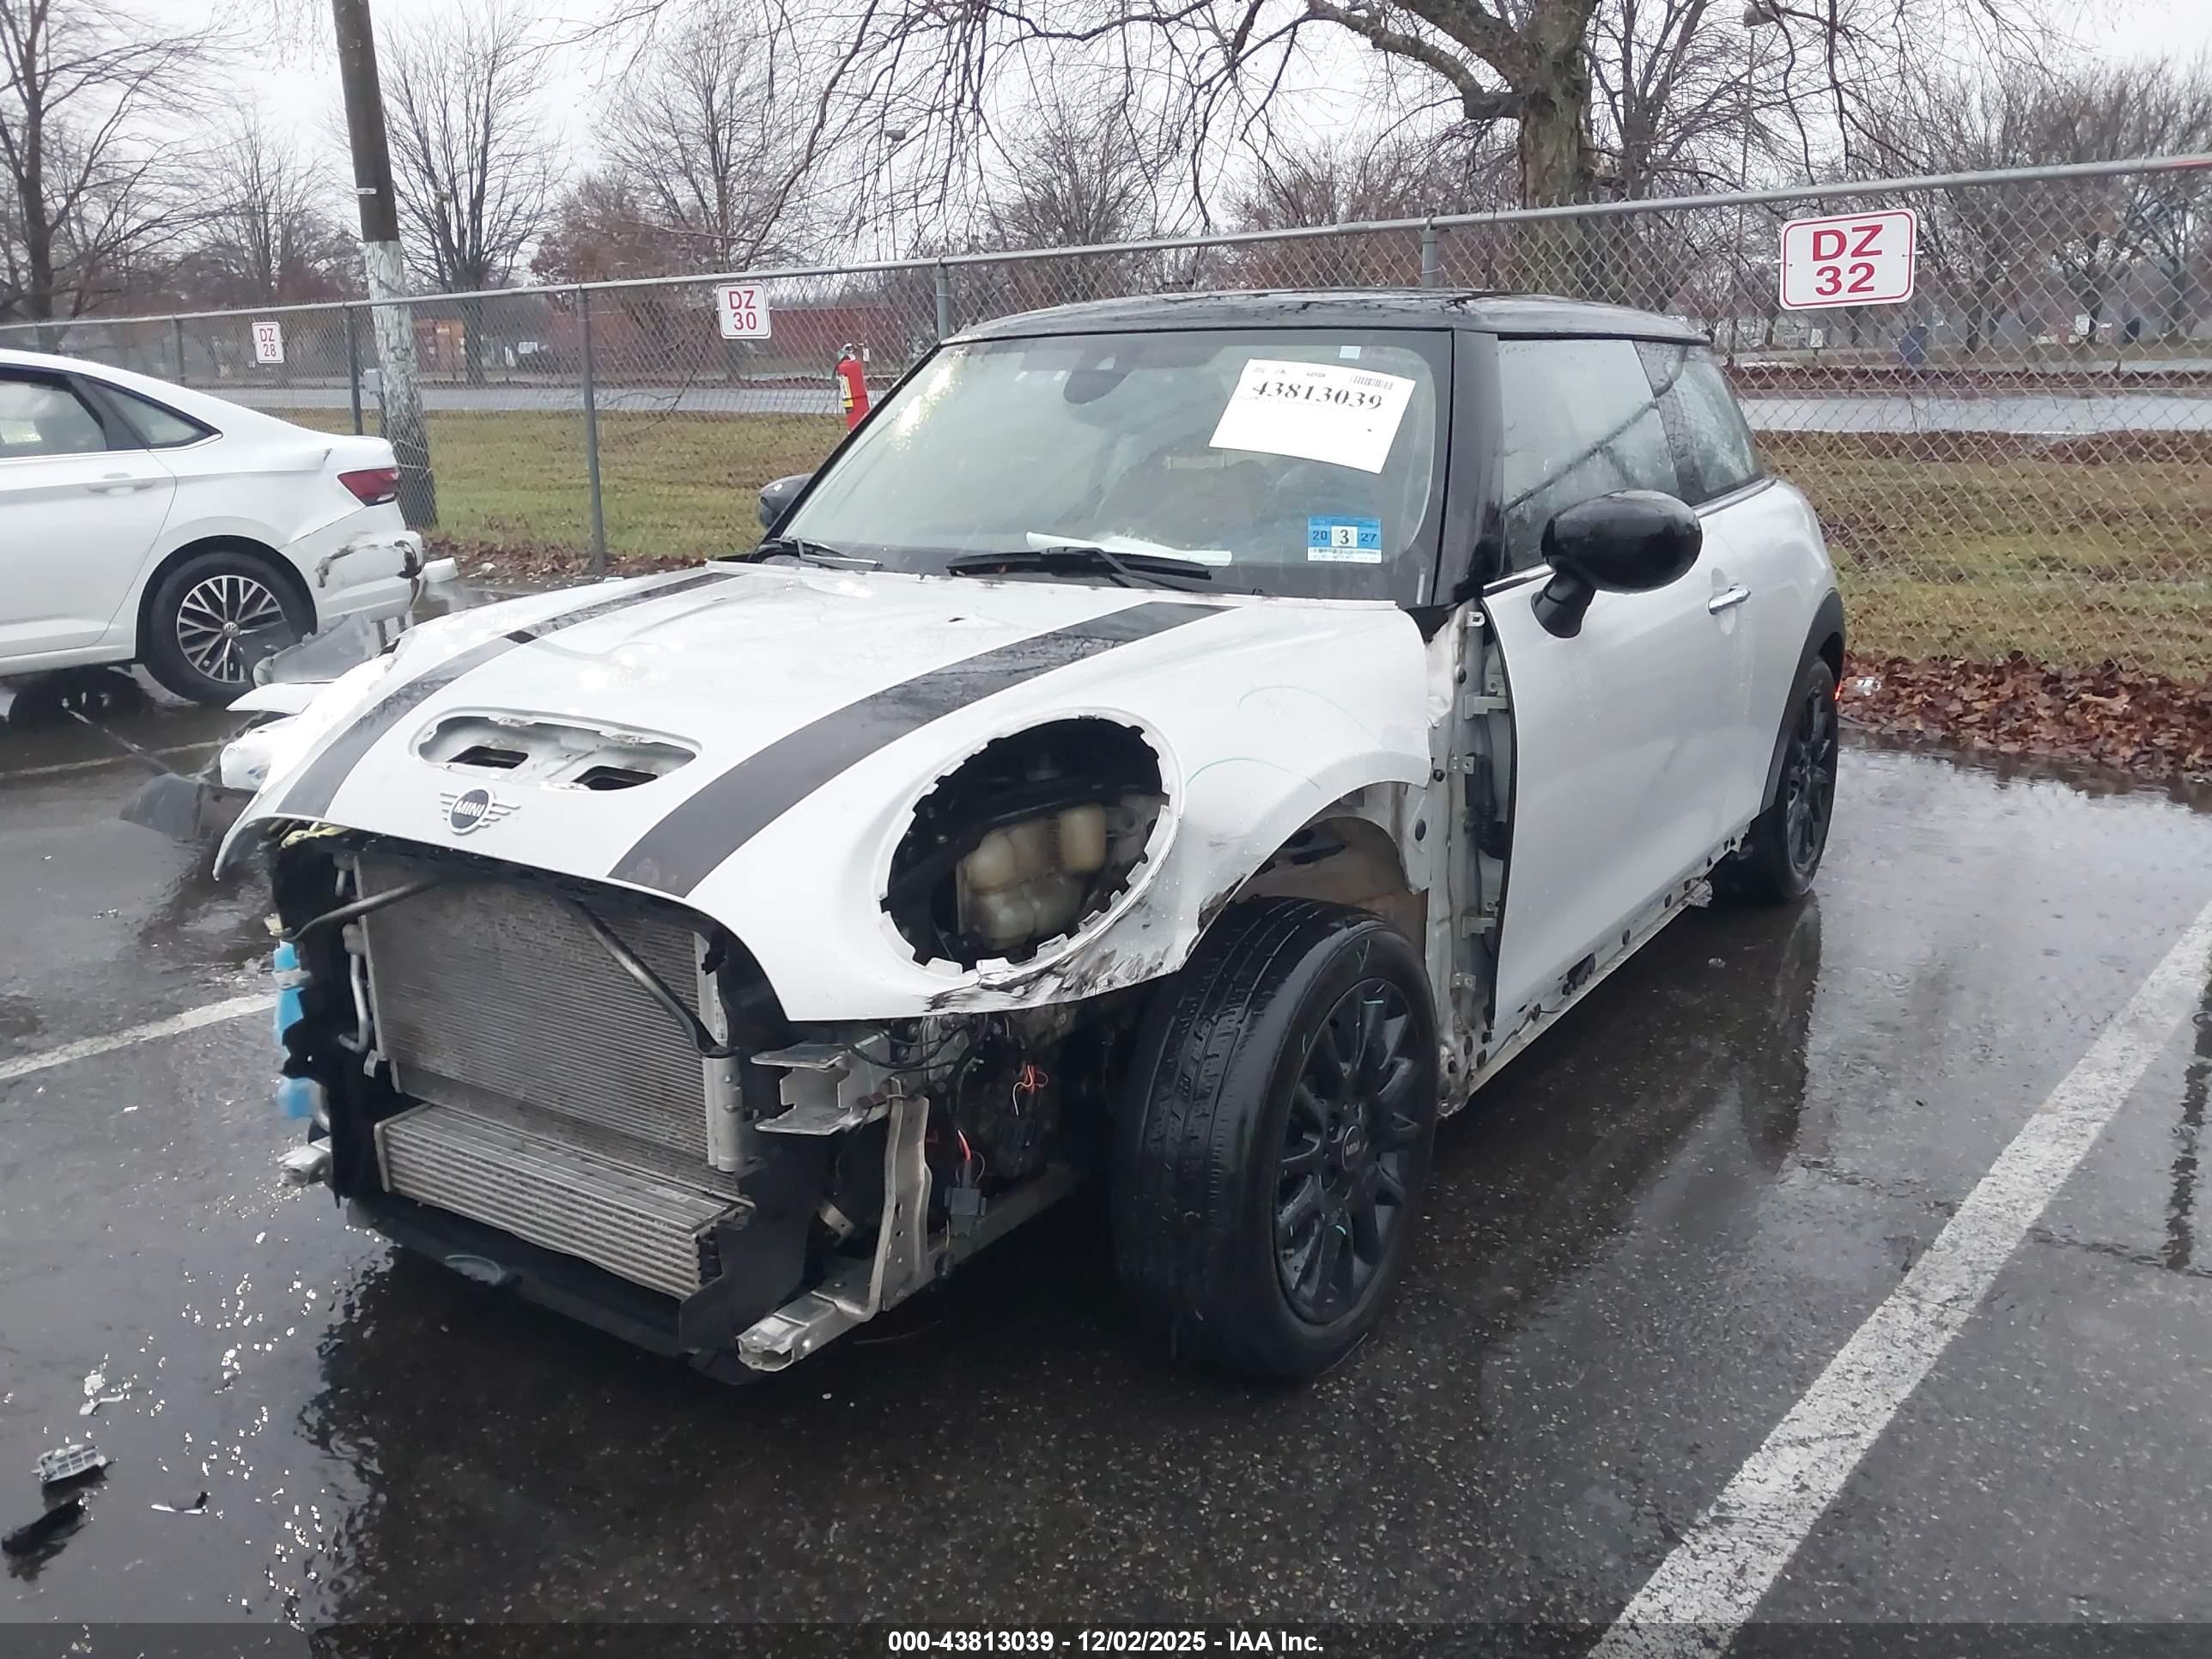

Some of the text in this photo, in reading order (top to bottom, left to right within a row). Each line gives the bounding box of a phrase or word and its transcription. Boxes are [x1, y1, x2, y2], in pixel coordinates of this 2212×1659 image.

[1812, 223, 1883, 262] DZ
[1814, 262, 1875, 296] 32
[727, 289, 757, 310] DZ
[732, 311, 757, 331] 30
[259, 328, 276, 343] DZ
[263, 343, 276, 357] 28
[1252, 380, 1382, 410] 43813039
[1312, 529, 1377, 545] 20 3 27
[453, 799, 486, 817] MINI
